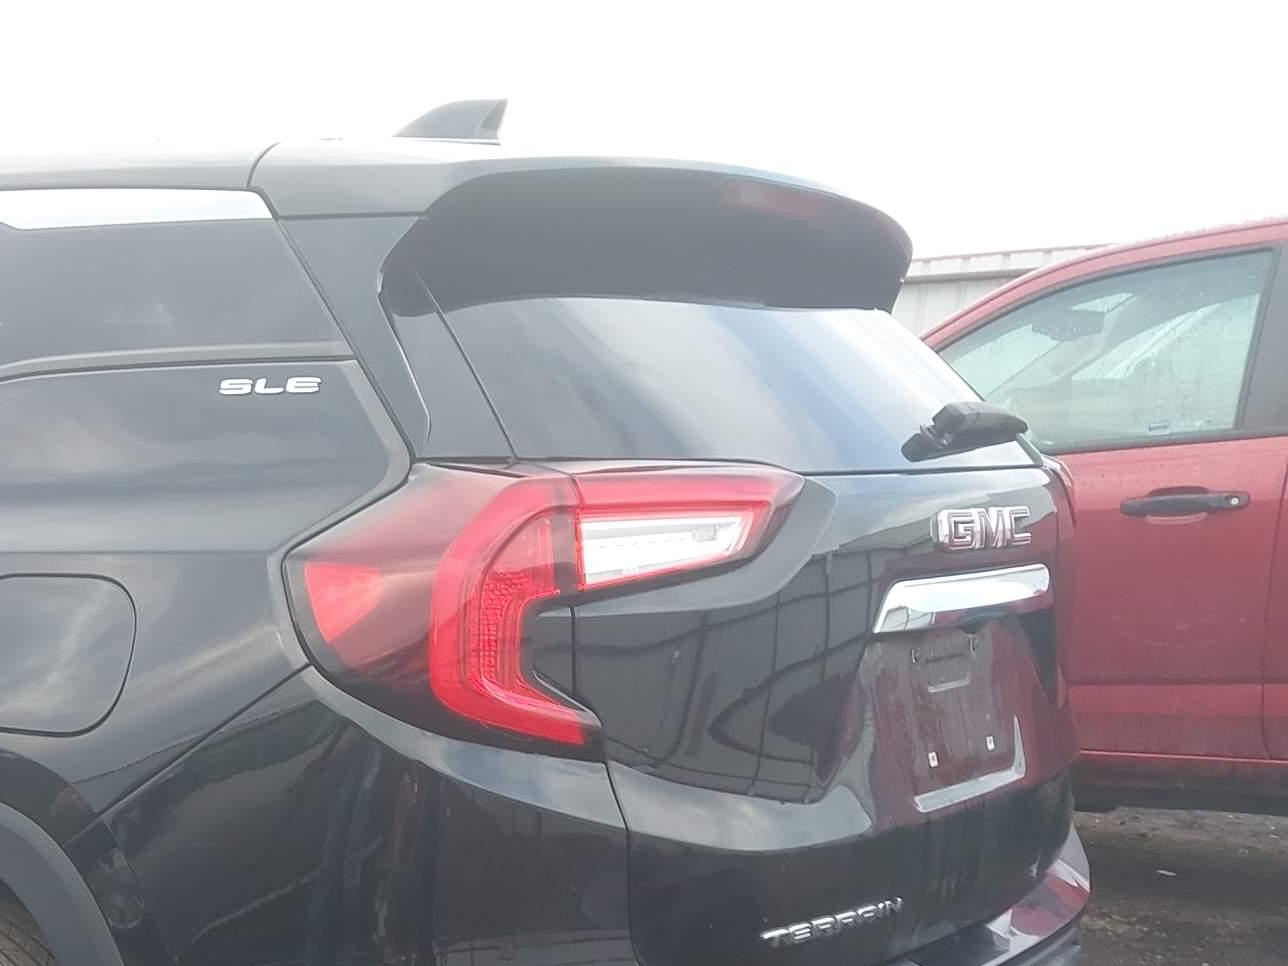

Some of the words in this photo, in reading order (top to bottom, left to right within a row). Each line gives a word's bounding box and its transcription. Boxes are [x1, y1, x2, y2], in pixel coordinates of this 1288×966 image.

[218, 376, 322, 395] SLE
[938, 505, 1032, 551] GMC
[761, 897, 904, 948] TERRAIN
